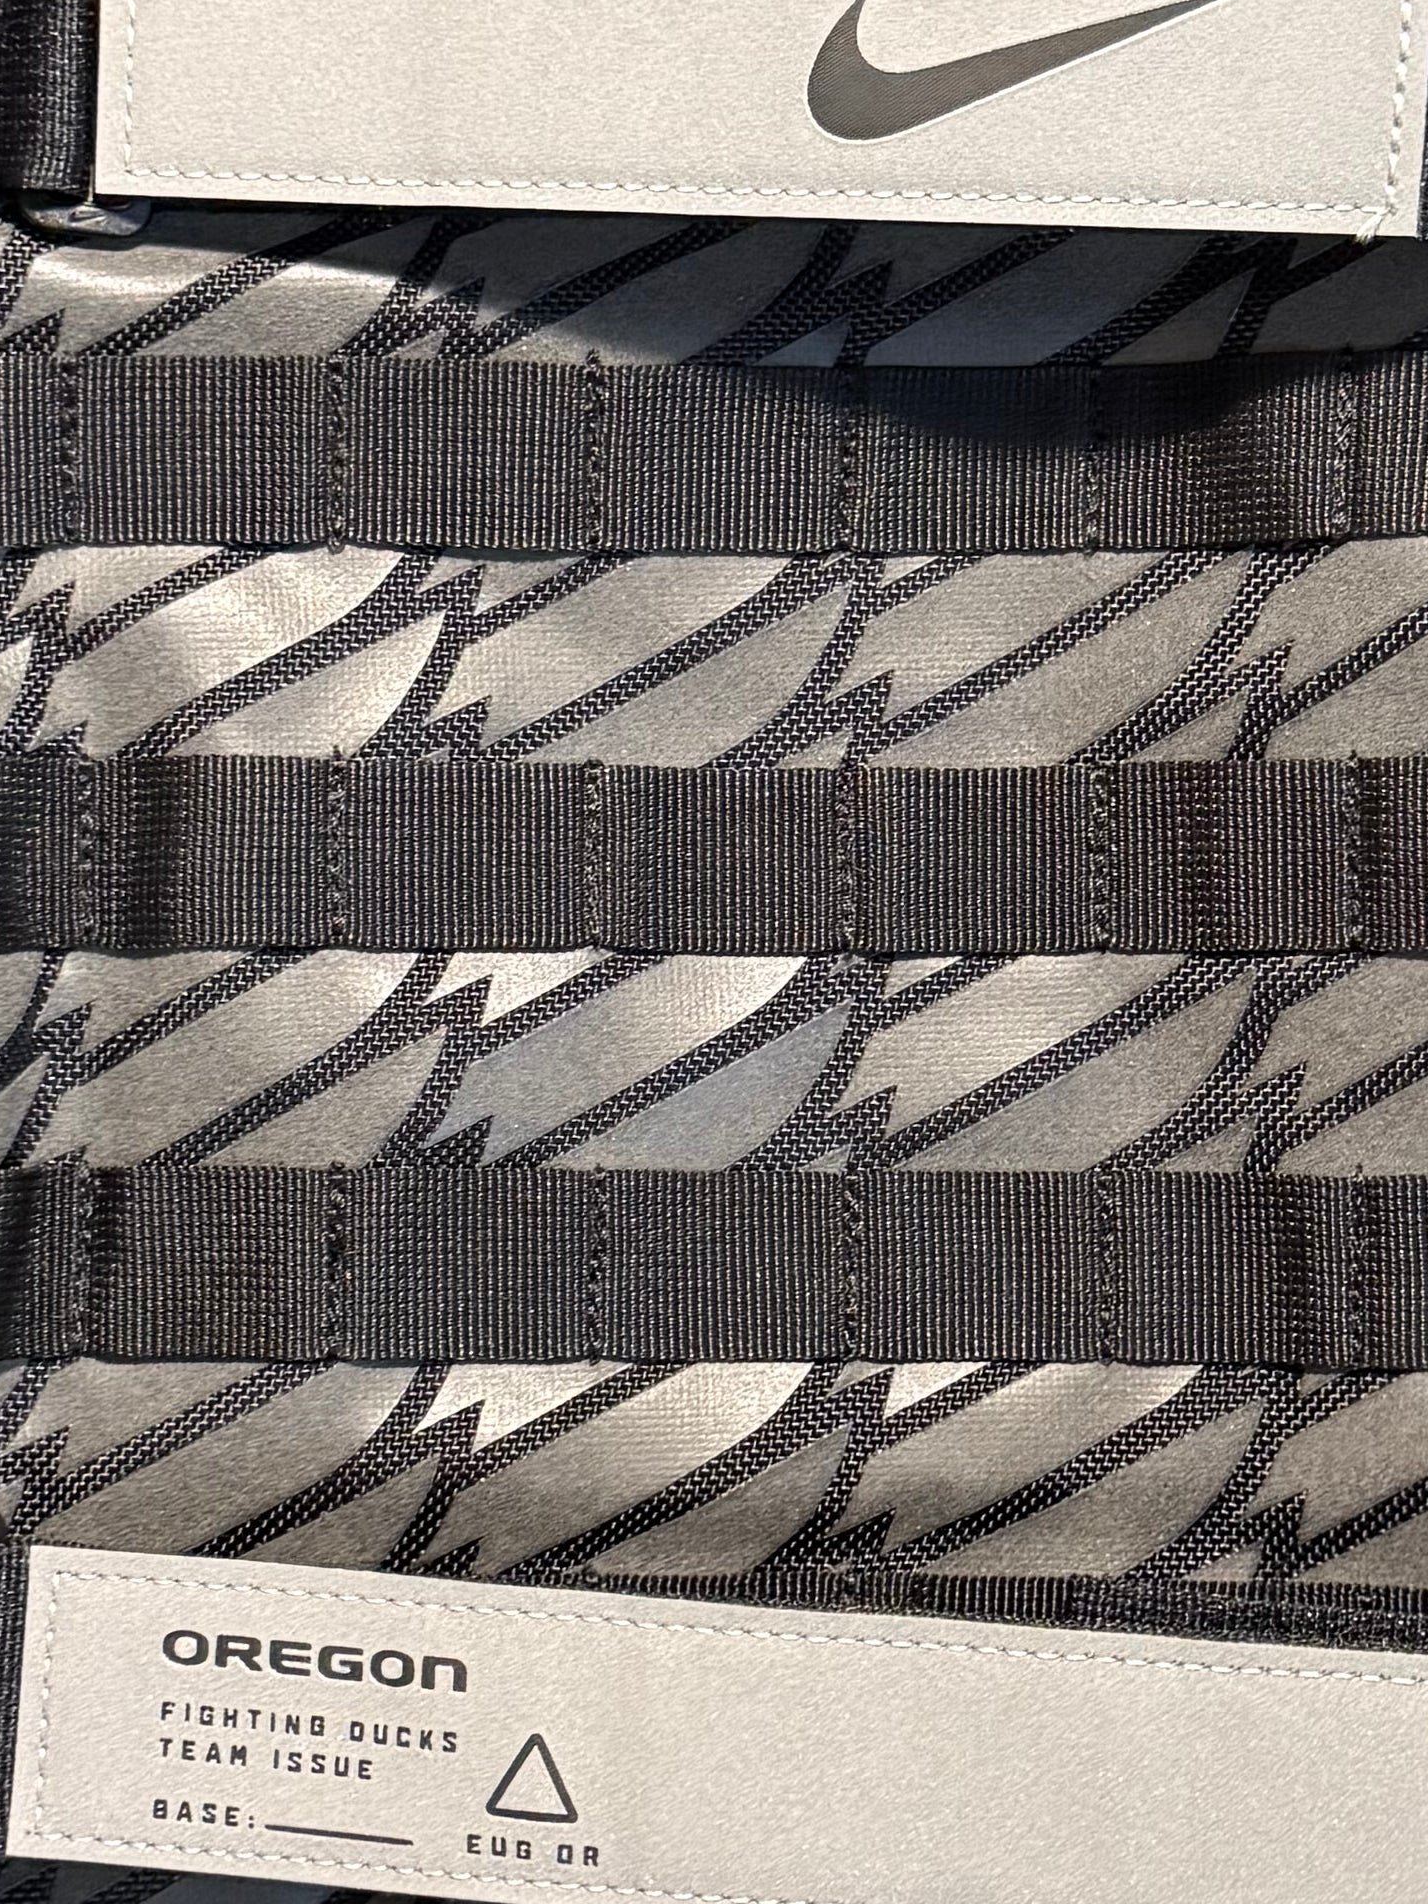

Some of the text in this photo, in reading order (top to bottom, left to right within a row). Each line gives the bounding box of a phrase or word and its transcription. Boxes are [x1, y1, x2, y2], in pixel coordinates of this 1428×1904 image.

[161, 1628, 468, 1693] OREGON
[160, 1700, 458, 1754] FIGHTING DUCKS
[159, 1738, 373, 1781] TEAM ISSUE
[466, 1834, 600, 1867] EUG OR
